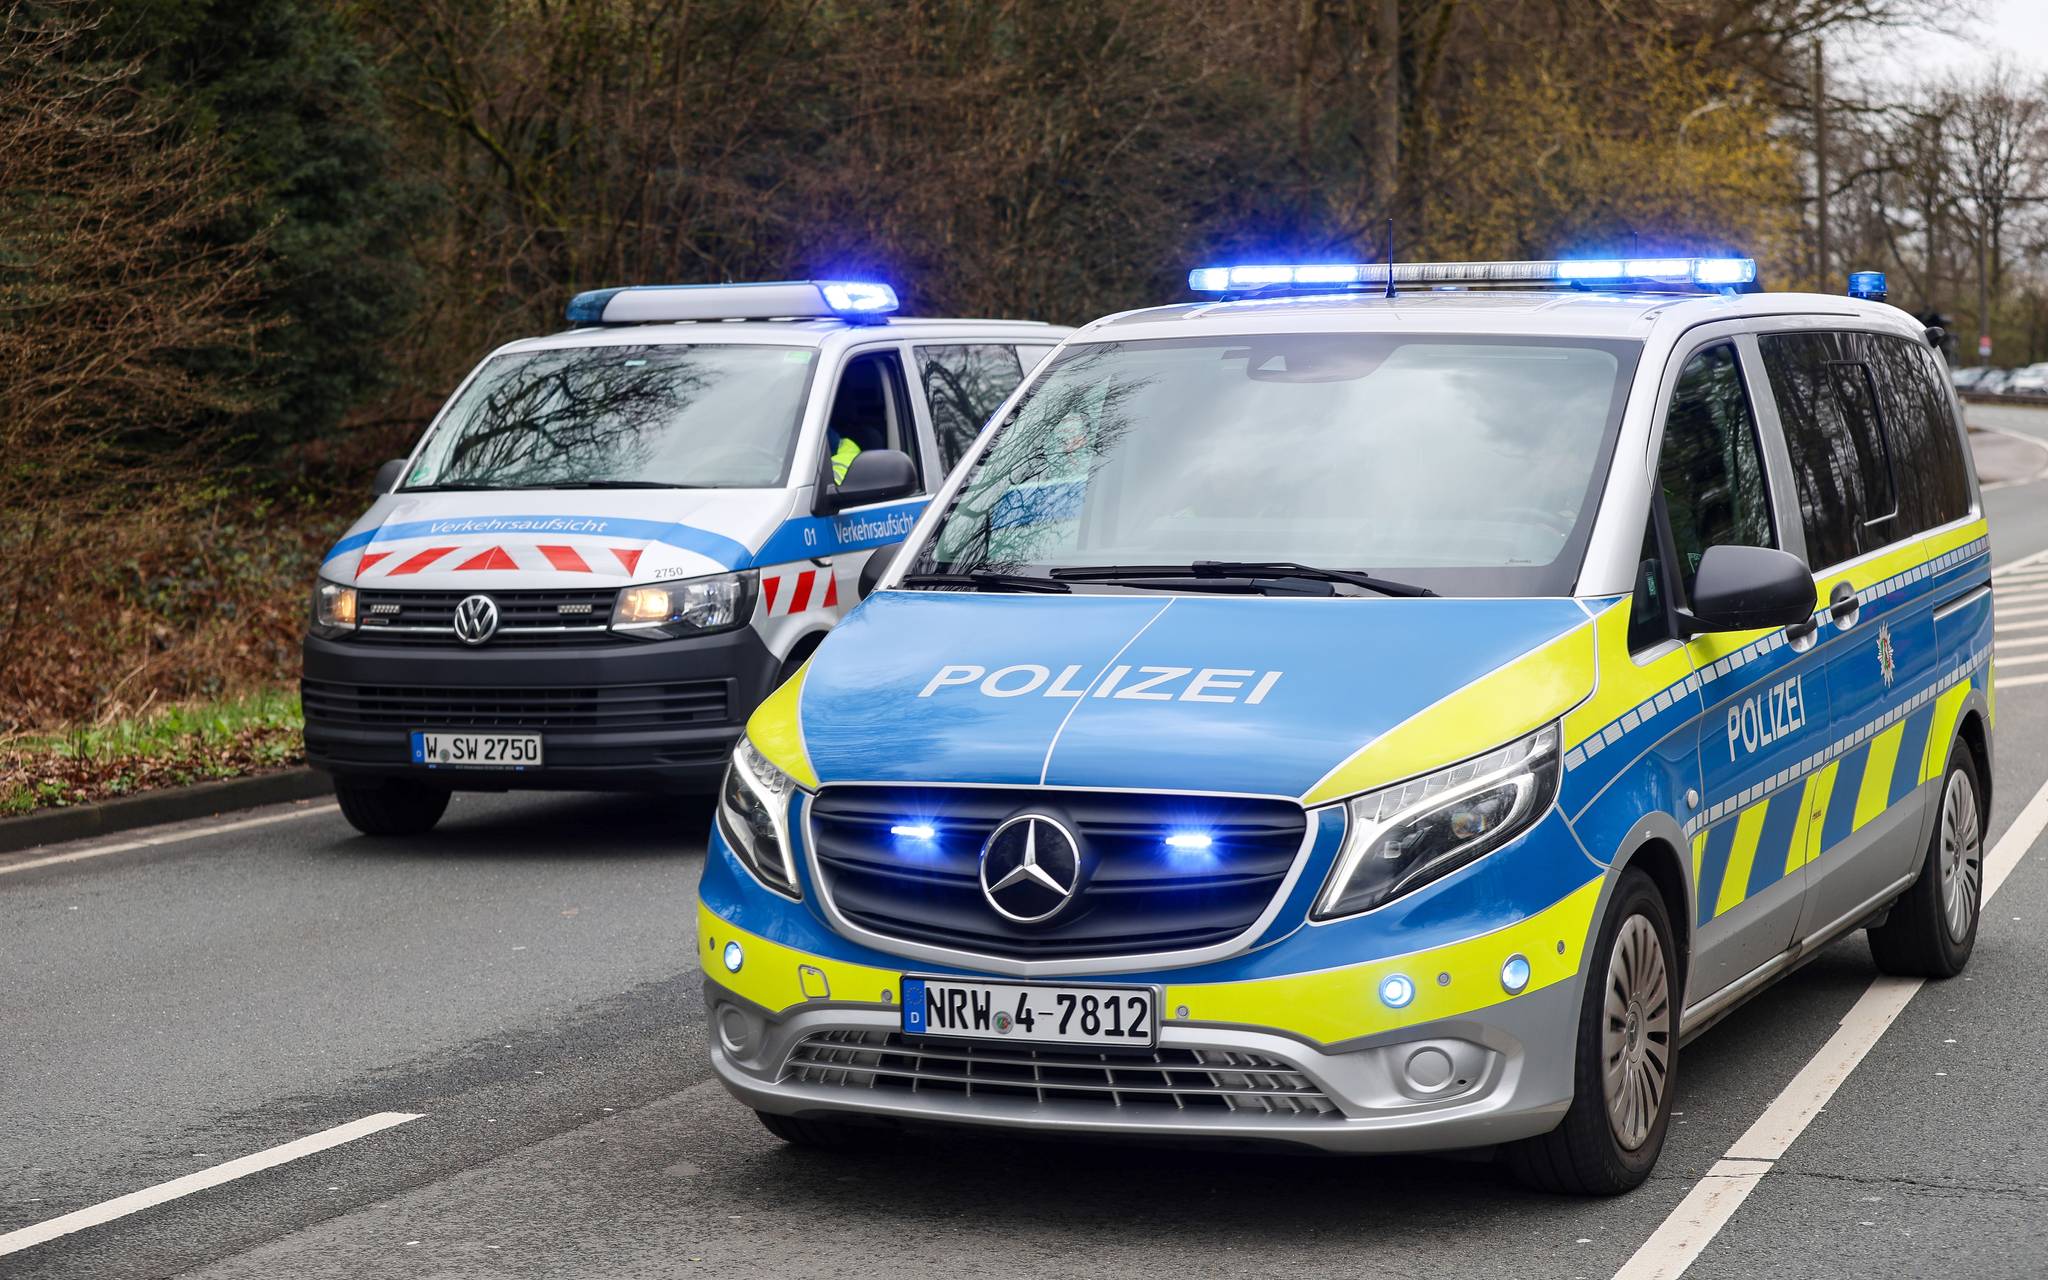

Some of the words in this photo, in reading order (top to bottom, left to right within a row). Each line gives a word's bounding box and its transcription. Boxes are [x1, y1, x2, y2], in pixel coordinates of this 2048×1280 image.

[430, 518, 608, 533] Verkehrsaufsicht
[803, 527, 817, 546] 01
[833, 512, 914, 545] Verkehrsaufsicht
[654, 566, 684, 578] 2750
[917, 664, 1284, 705] POLIZEI
[1727, 673, 1806, 762] POLIZEI
[425, 736, 438, 759] W
[452, 737, 478, 760] SW
[484, 738, 538, 761] 2750
[910, 1012, 919, 1024] D
[925, 986, 991, 1031] NRW
